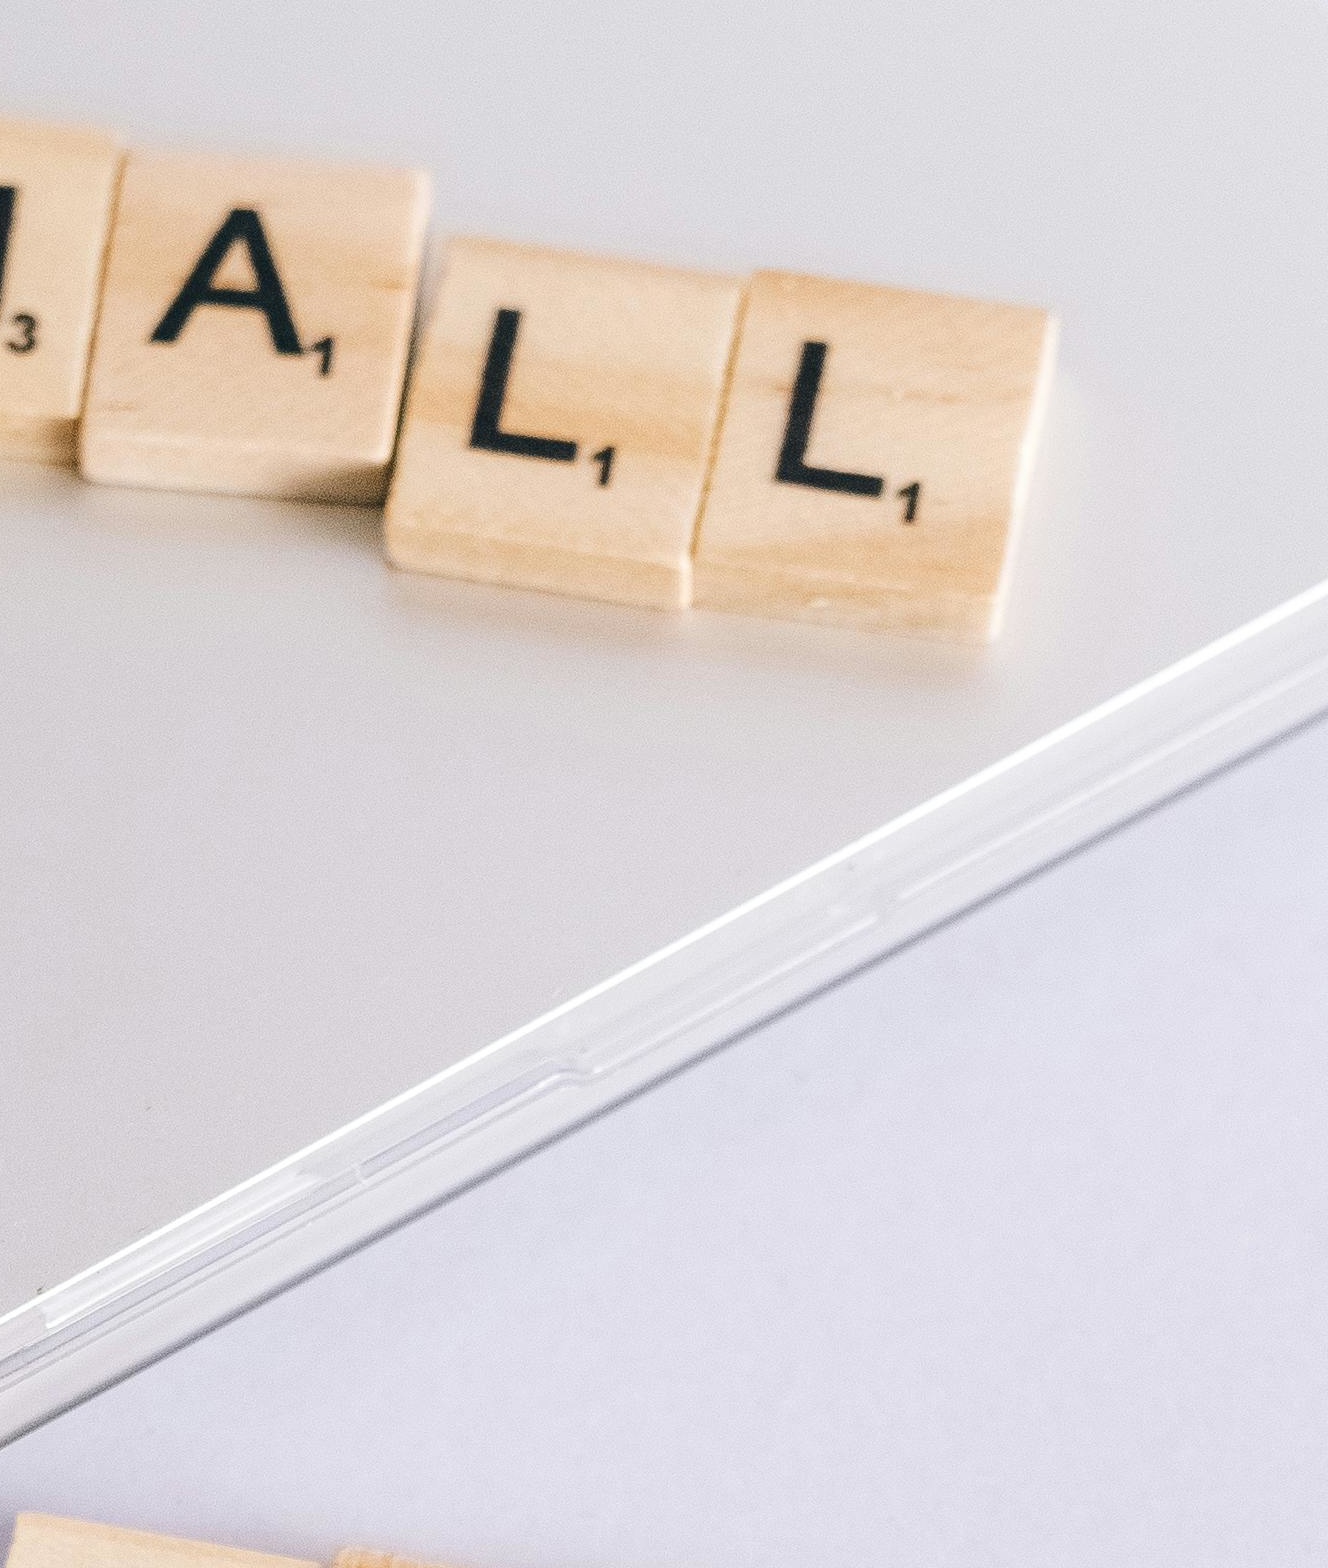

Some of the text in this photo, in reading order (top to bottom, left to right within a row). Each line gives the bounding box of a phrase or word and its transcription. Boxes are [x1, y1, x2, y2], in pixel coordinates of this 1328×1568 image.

[9, 314, 36, 352] 3
[312, 337, 333, 375] 1
[594, 446, 614, 485] 1
[900, 483, 919, 522] 1
